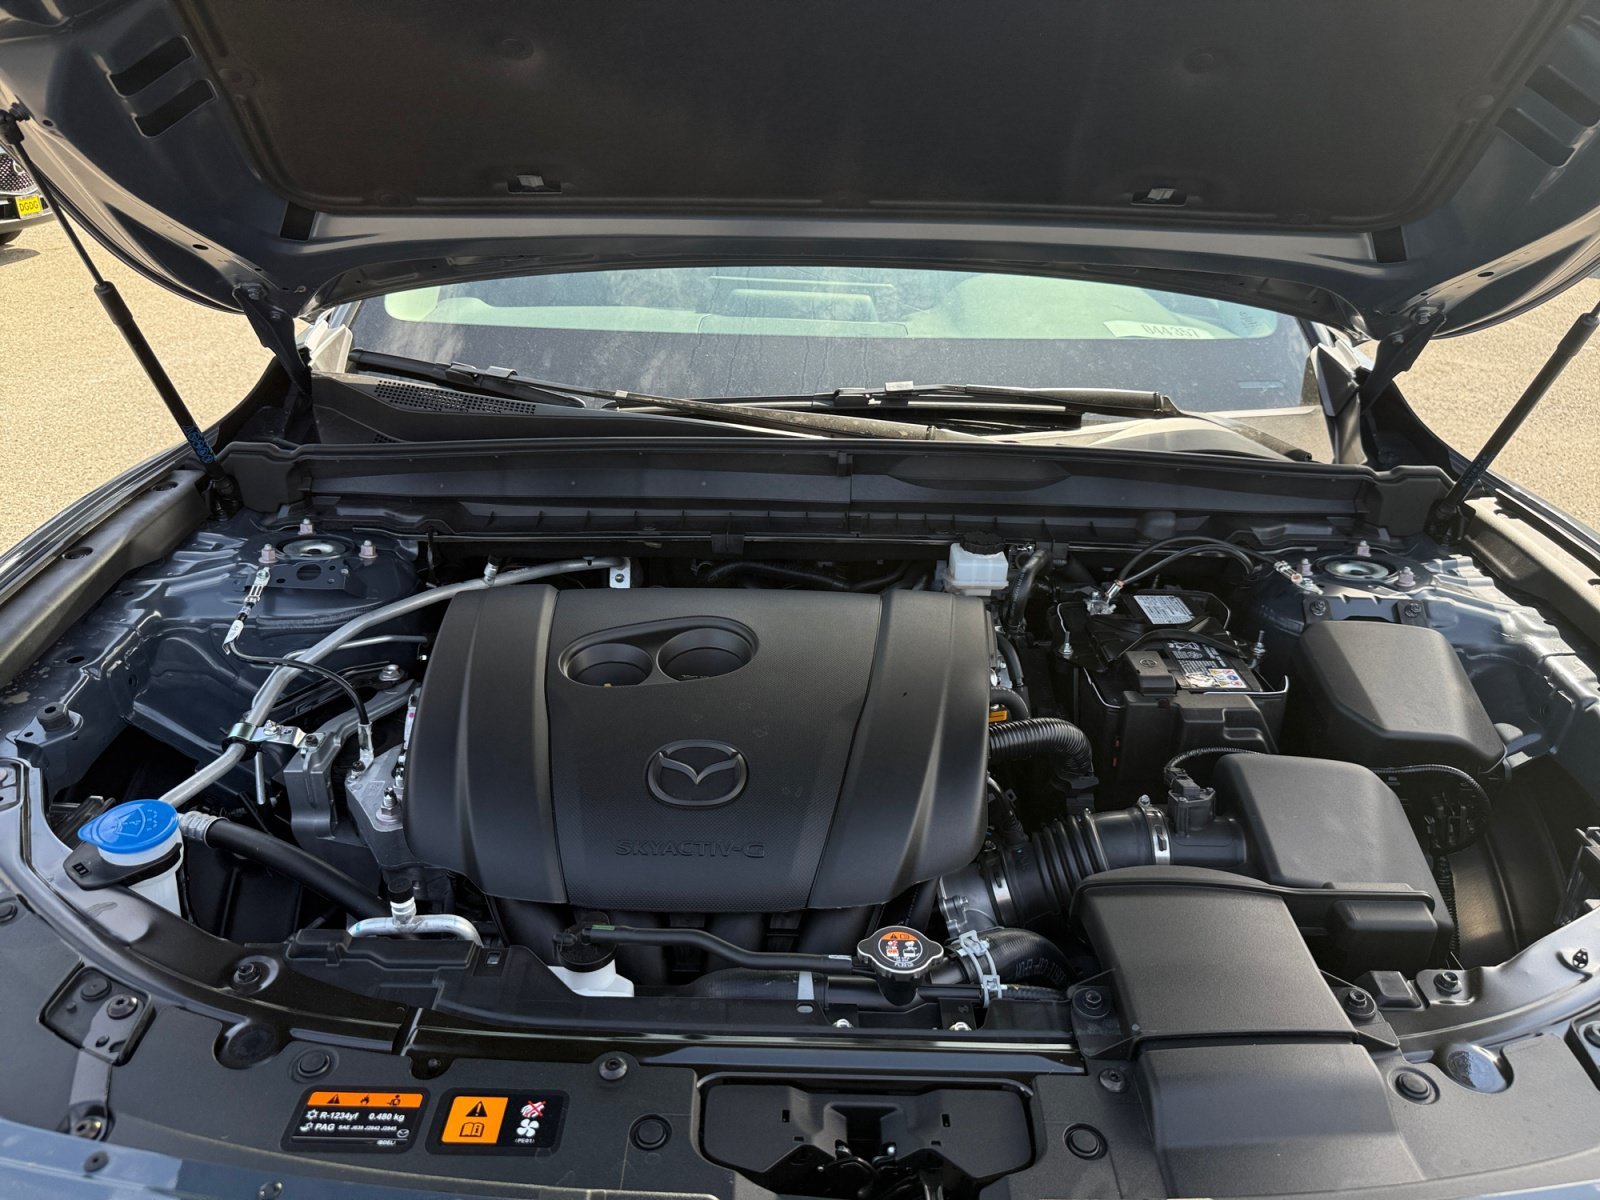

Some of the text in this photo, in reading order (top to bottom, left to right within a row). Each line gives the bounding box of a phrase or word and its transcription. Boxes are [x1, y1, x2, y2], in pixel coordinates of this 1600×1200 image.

[615, 840, 765, 858] SKYACTIV-G
[320, 1111, 406, 1123] R-1234yf 0.480 kg
[314, 1123, 336, 1132] PAG
